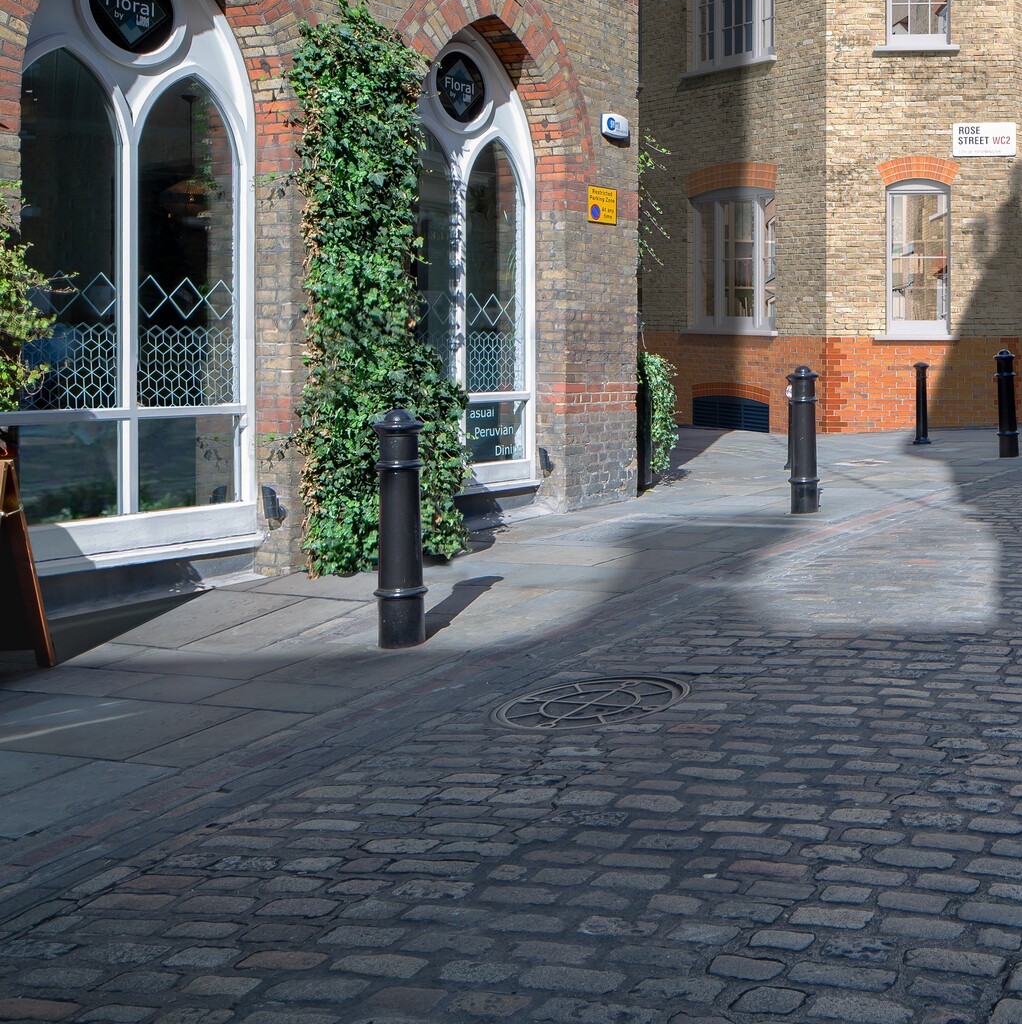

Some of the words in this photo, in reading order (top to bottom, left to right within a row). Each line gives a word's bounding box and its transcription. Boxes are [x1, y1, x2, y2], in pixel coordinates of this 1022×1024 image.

[114, 10, 124, 20] by
[444, 76, 475, 95] Floral
[958, 126, 980, 135] ROSE
[958, 136, 989, 145] STREET
[992, 136, 1011, 144] WC2
[592, 188, 613, 196] Restricted
[590, 194, 604, 202] Parking
[467, 406, 495, 419] asual
[475, 425, 514, 438] Peruvian
[495, 443, 520, 457] Dini
